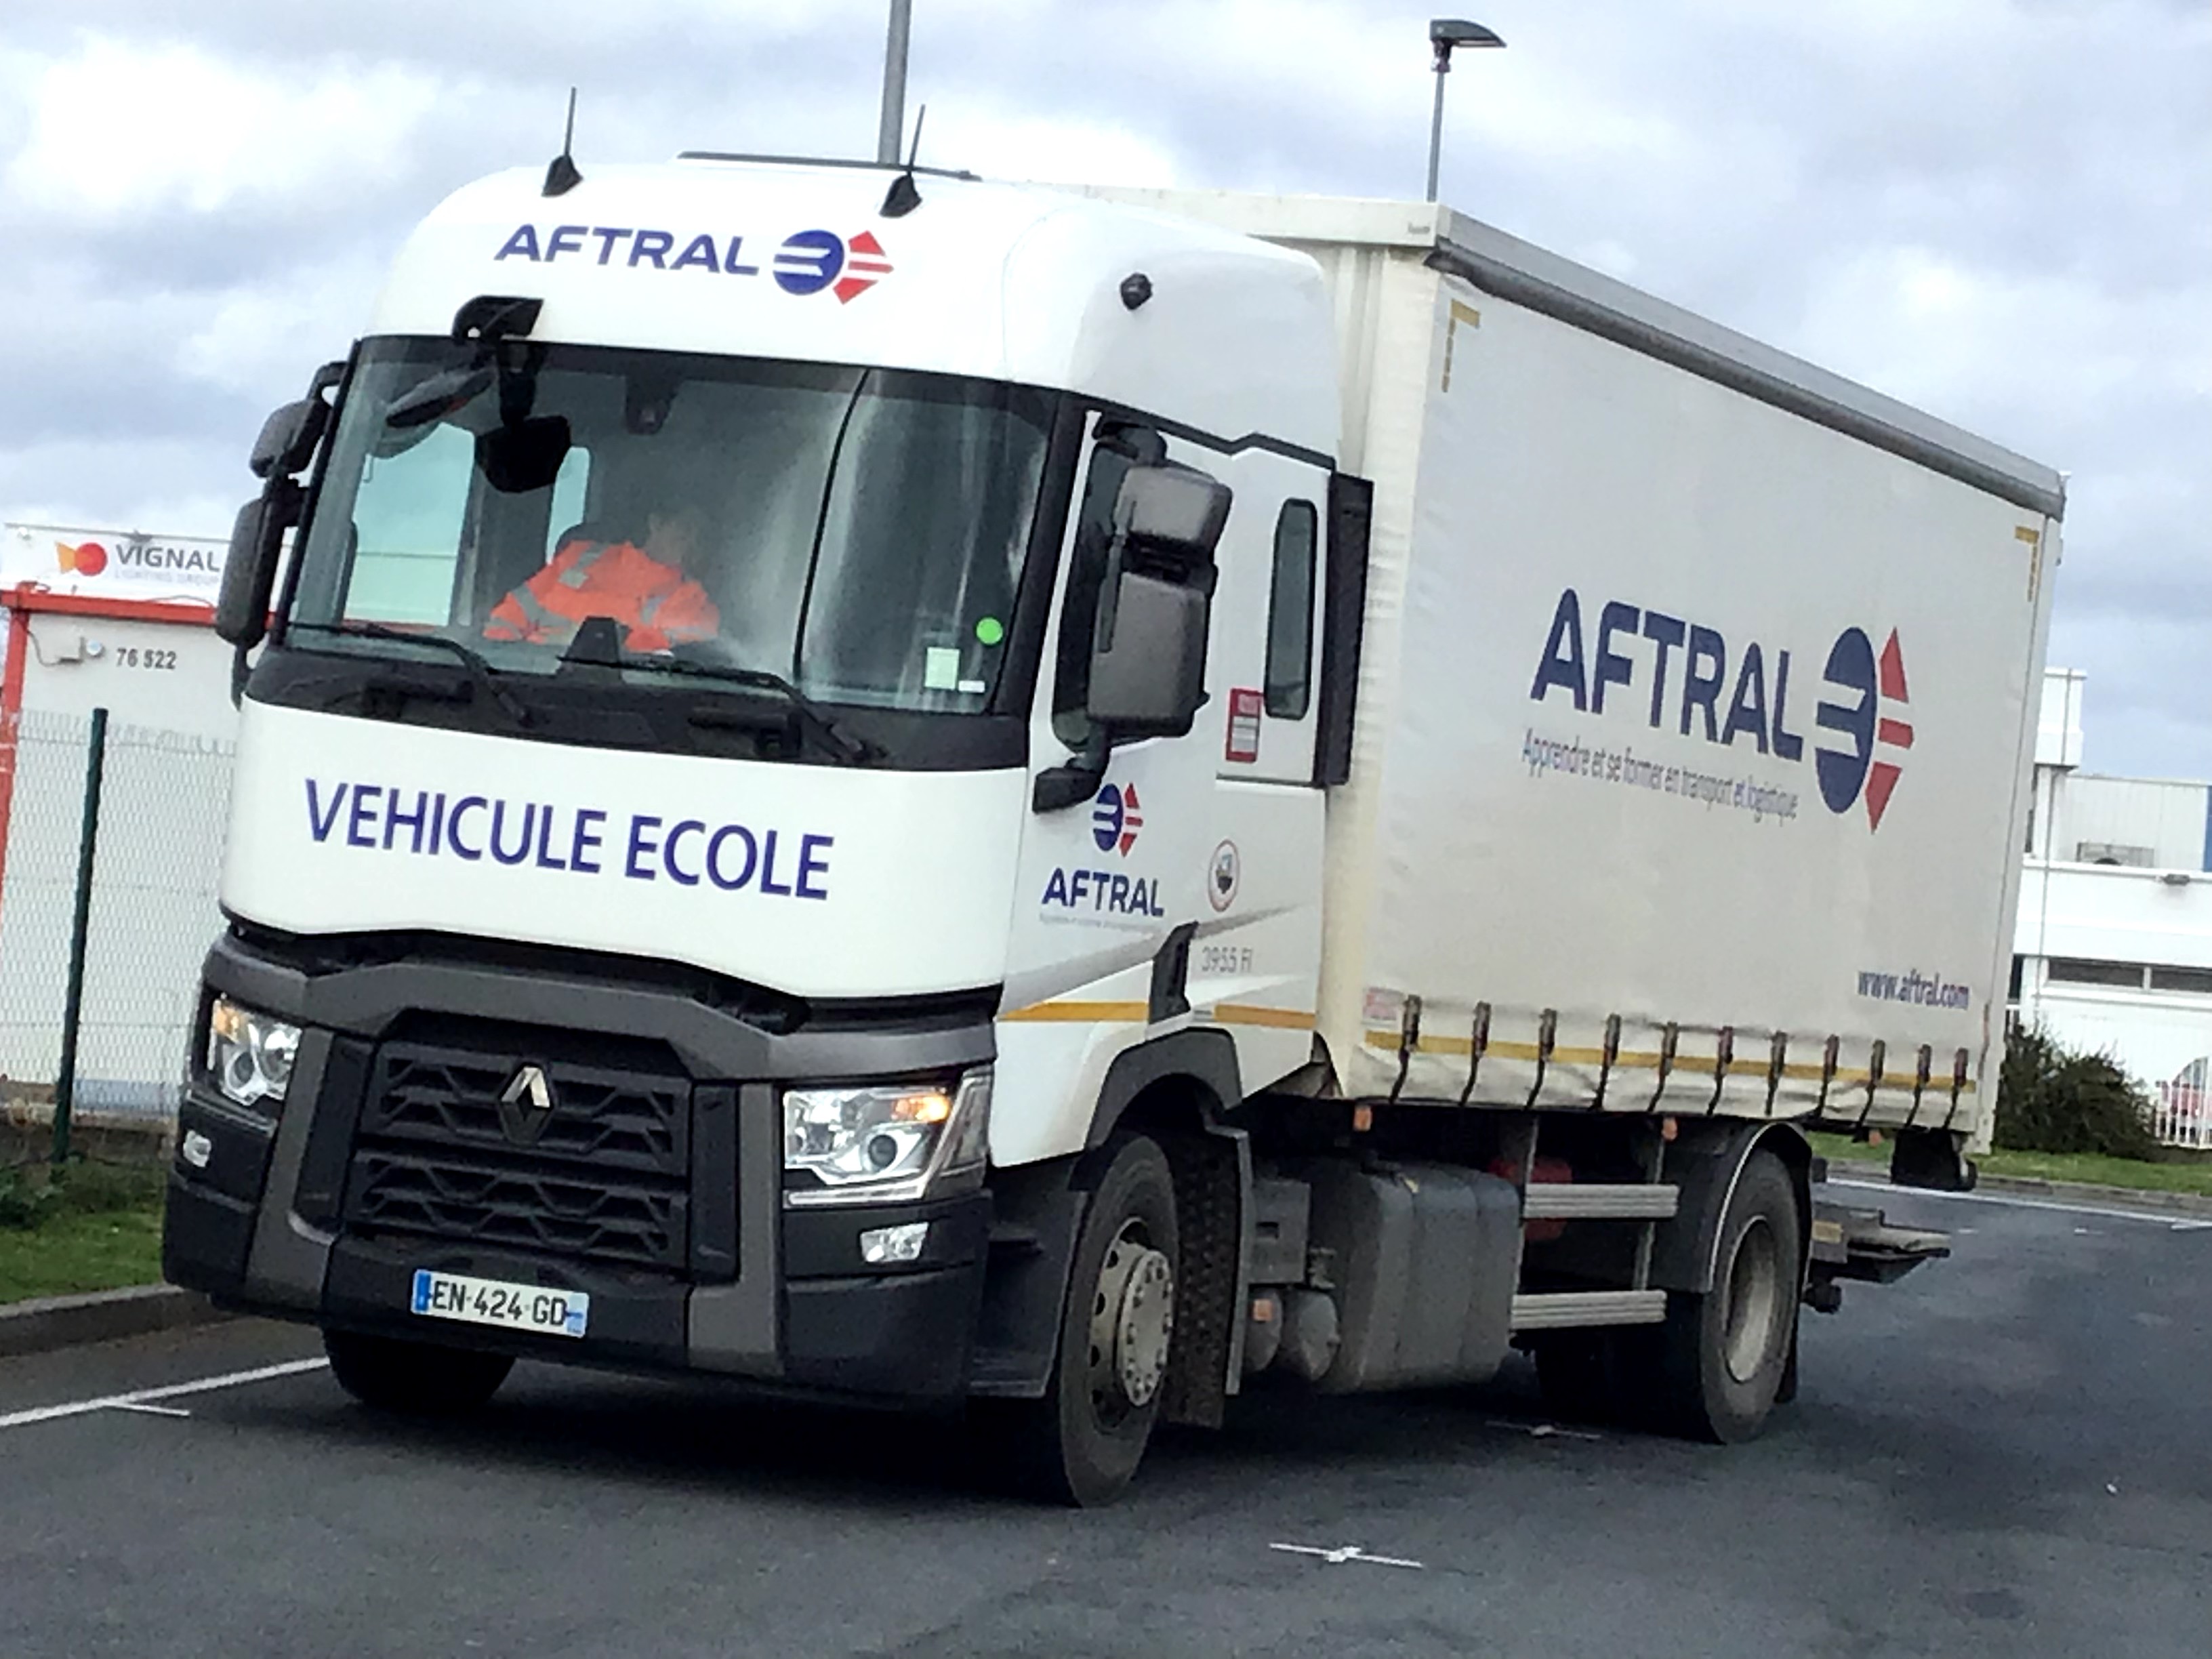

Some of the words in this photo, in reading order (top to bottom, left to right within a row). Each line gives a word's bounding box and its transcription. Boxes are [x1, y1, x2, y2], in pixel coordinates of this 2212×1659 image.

[494, 224, 760, 276] AFTRAL
[116, 544, 220, 572] VIGNAL
[117, 649, 138, 667] 76
[1530, 588, 1804, 762] AFTRAL
[1522, 728, 1590, 778] Apprendre
[306, 779, 607, 874] VEHICULE
[625, 815, 834, 901] ECOLE
[1042, 867, 1164, 917] AFTRAL
